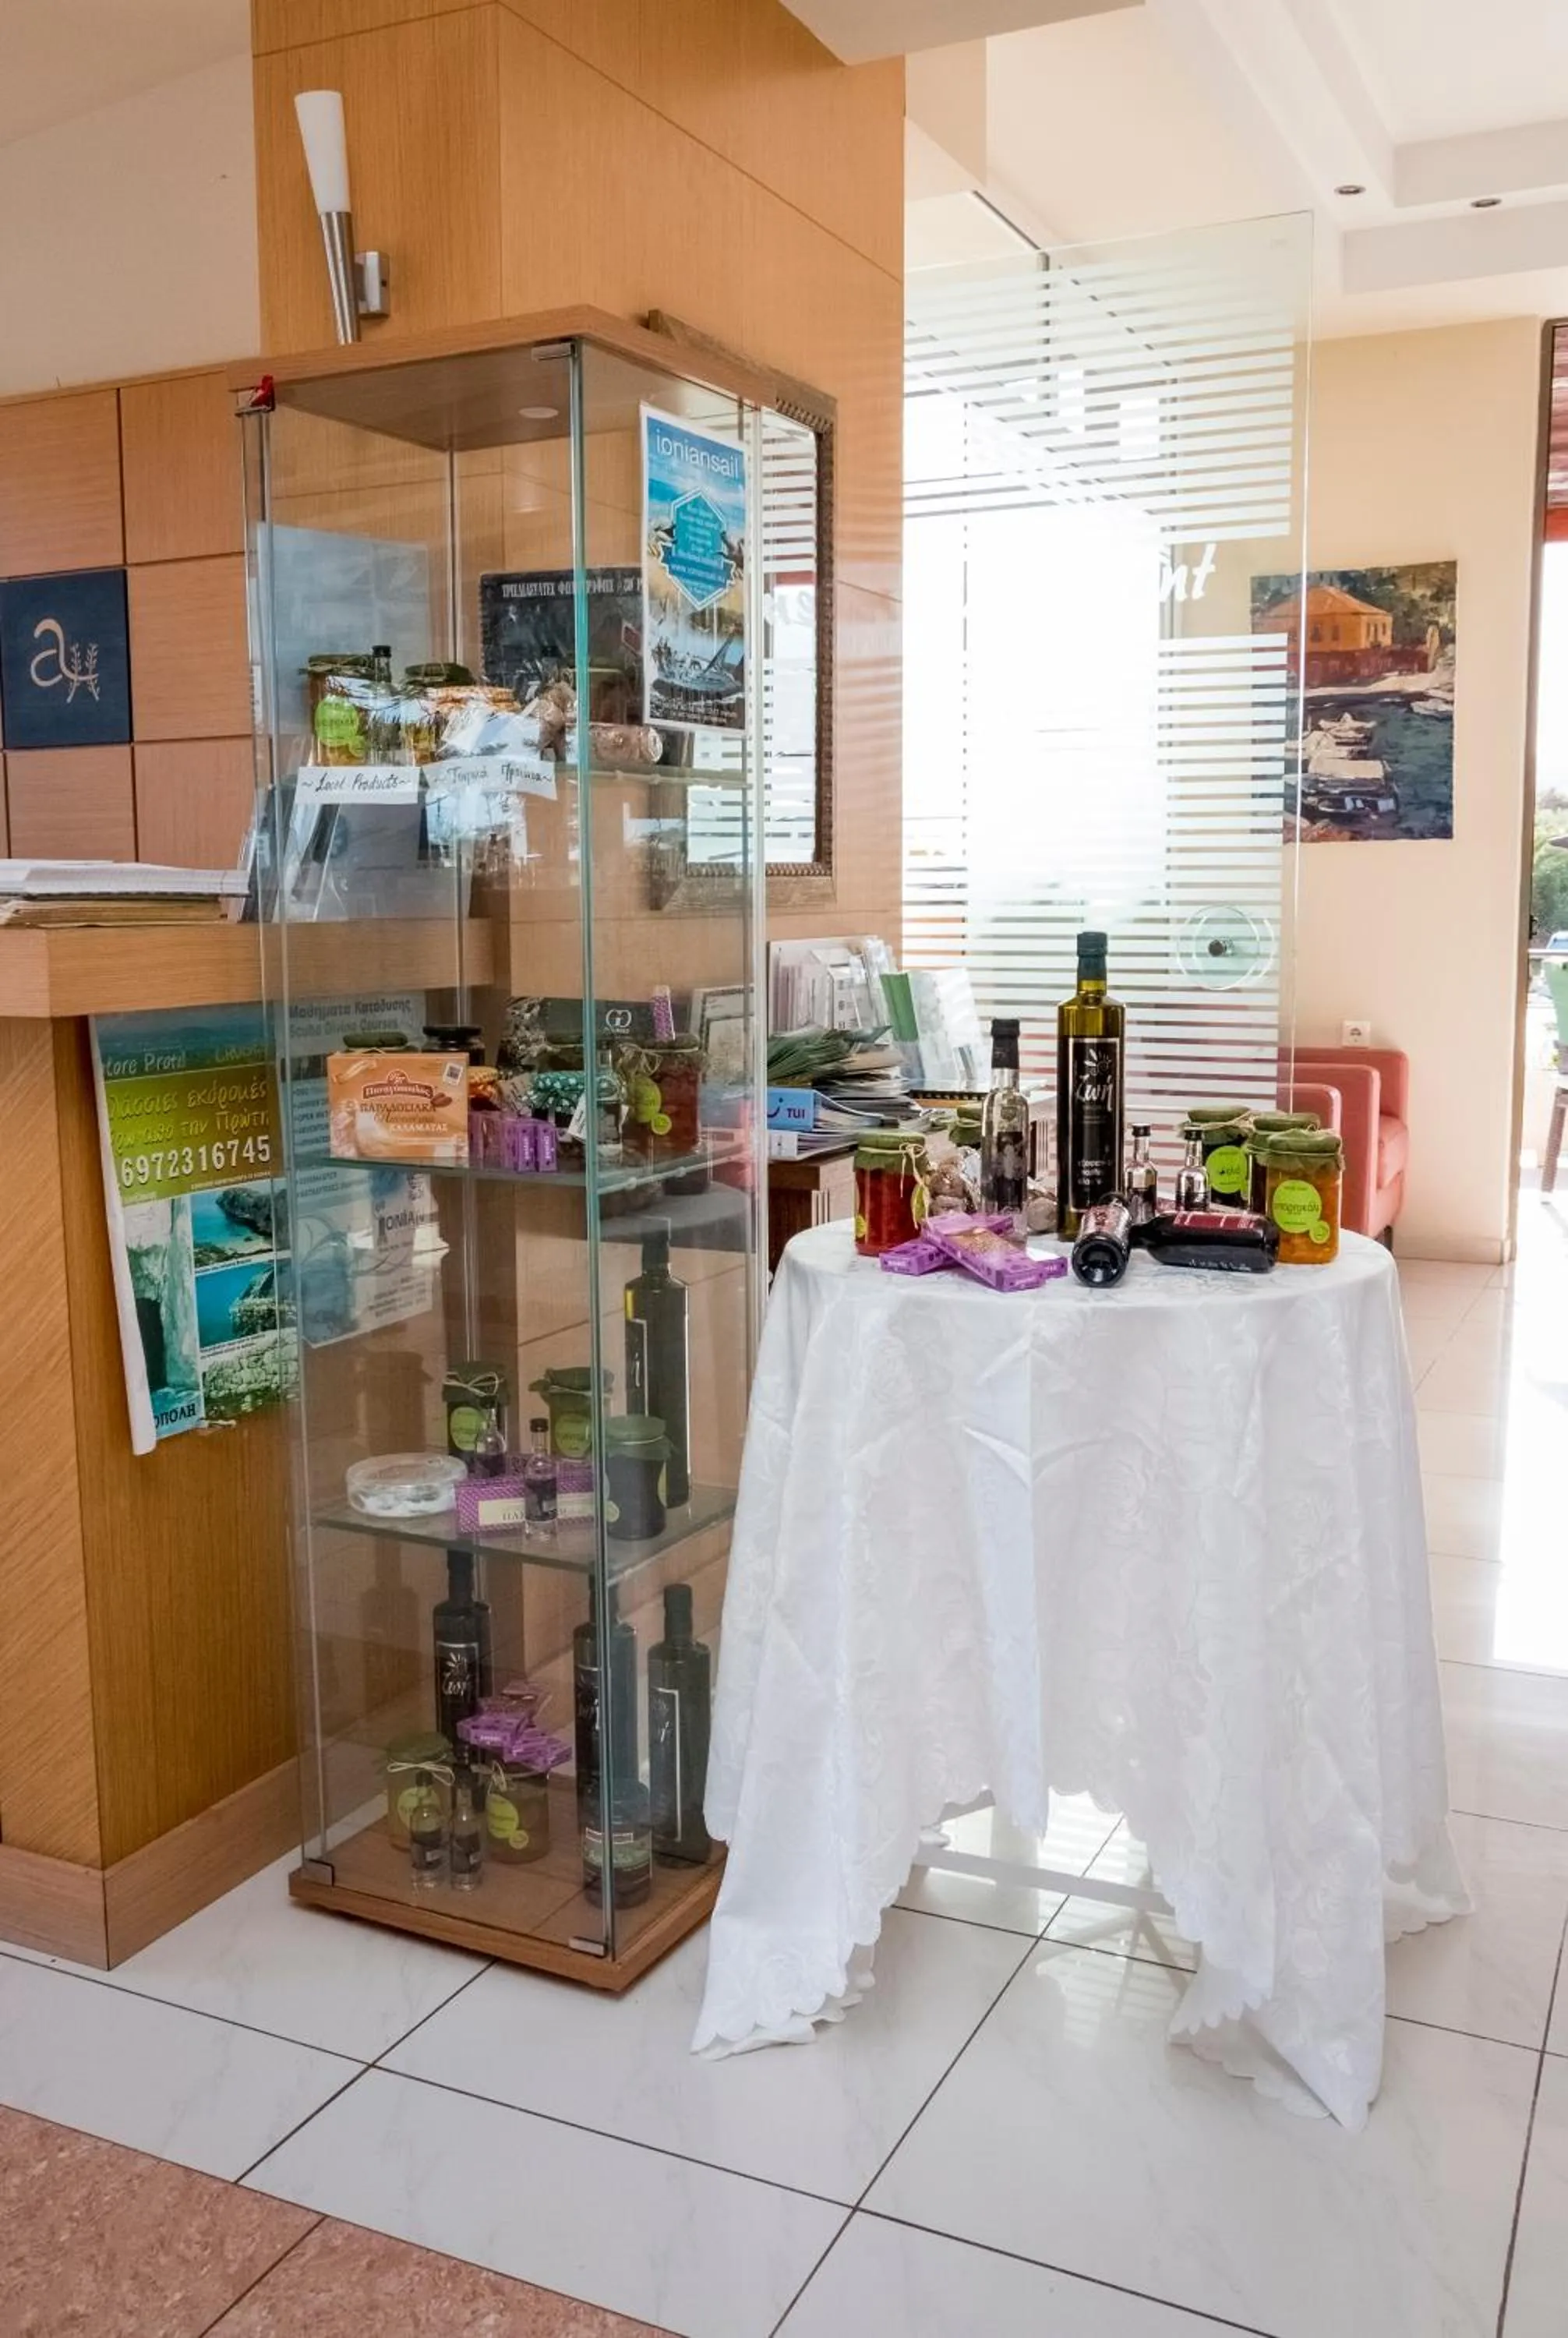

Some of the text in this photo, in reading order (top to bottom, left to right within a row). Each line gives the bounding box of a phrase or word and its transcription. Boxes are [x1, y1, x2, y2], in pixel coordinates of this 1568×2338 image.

[656, 428, 739, 479] ioniansail
[315, 772, 398, 793] Local Products
[786, 1107, 805, 1120] TUI
[121, 1135, 271, 1188] 6972316745
